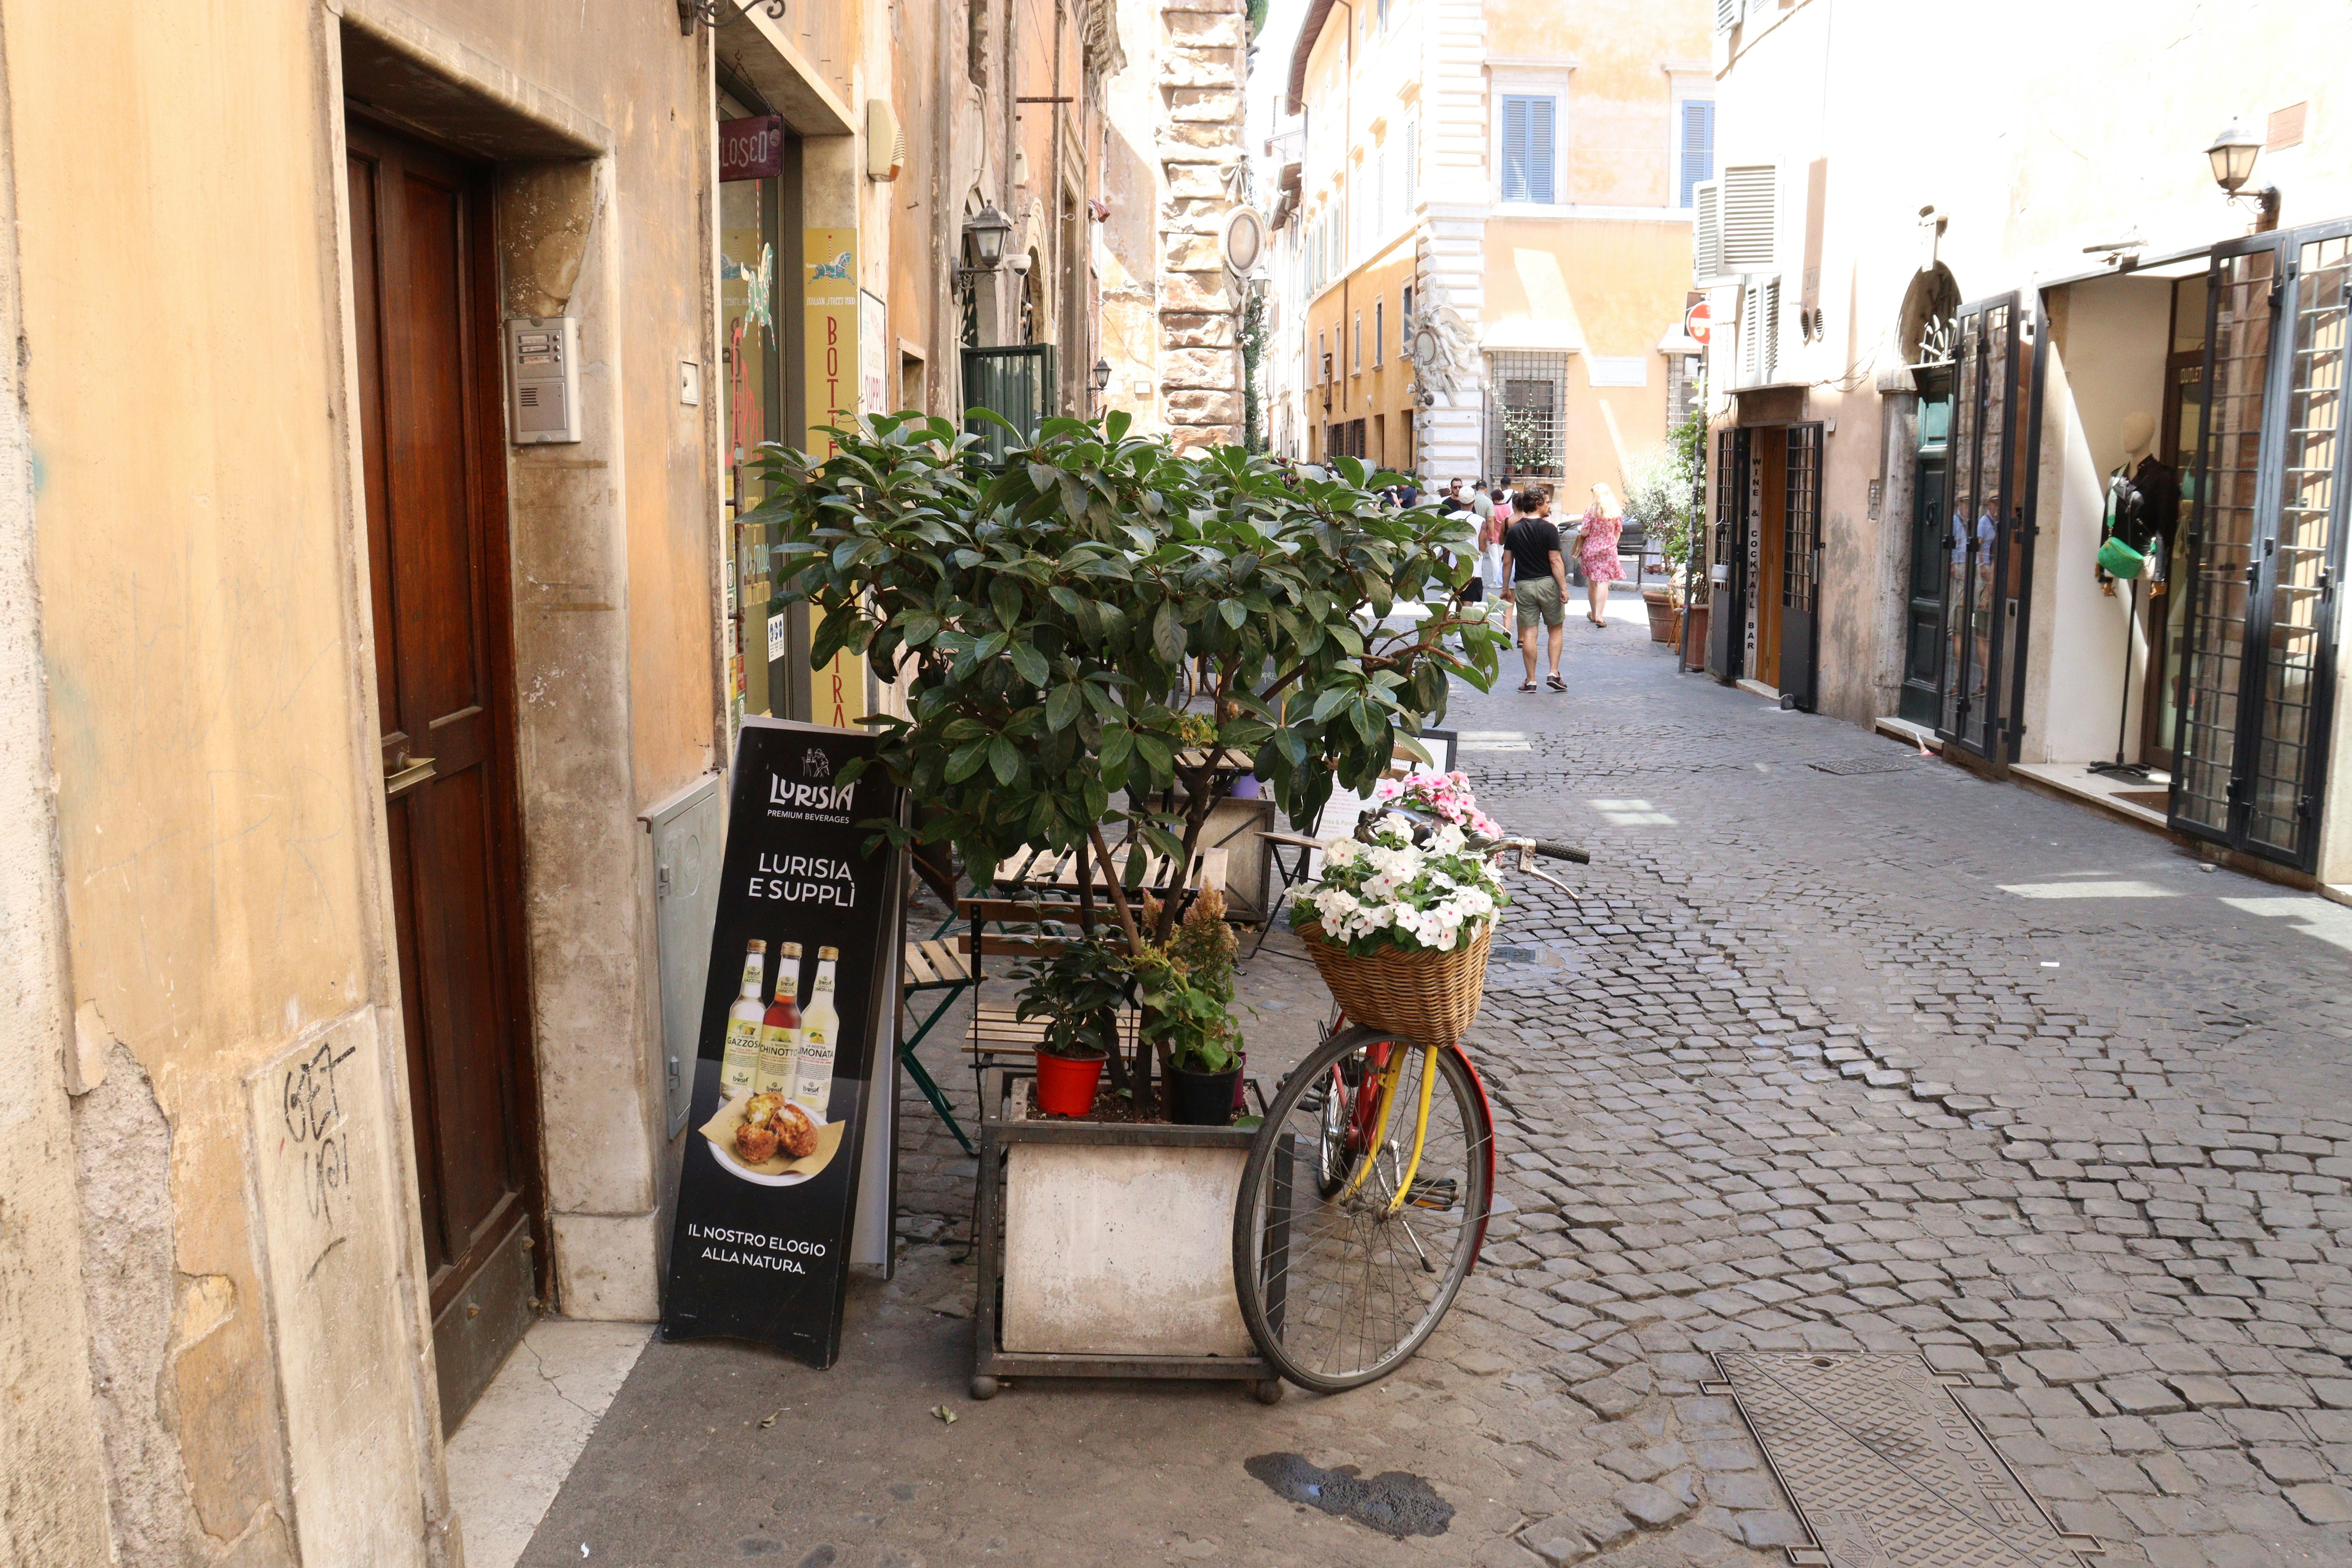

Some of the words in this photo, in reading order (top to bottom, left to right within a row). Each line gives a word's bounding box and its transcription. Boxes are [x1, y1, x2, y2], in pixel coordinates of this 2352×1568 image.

[719, 131, 768, 168] LOSED
[807, 297, 825, 305] ITALIAN
[826, 297, 844, 305] STREET
[1752, 458, 1761, 496] WINE
[1749, 530, 1758, 609] COCKTAIL
[770, 773, 856, 811] LURISIA
[767, 809, 804, 820] PREMIUM
[805, 812, 850, 824] BEVERAGES
[759, 853, 853, 882] LURISIA
[748, 877, 762, 897] E
[768, 878, 856, 907] SUPPLÌ
[760, 1044, 798, 1057] CHINOTTO
[688, 1223, 701, 1238] IL
[703, 1226, 766, 1248] NOSTRO
[769, 1237, 826, 1257] ELOGIO
[701, 1247, 739, 1264] ALLA
[742, 1253, 806, 1275] NATURA.
[1936, 1416, 2016, 1501] FiberCop
